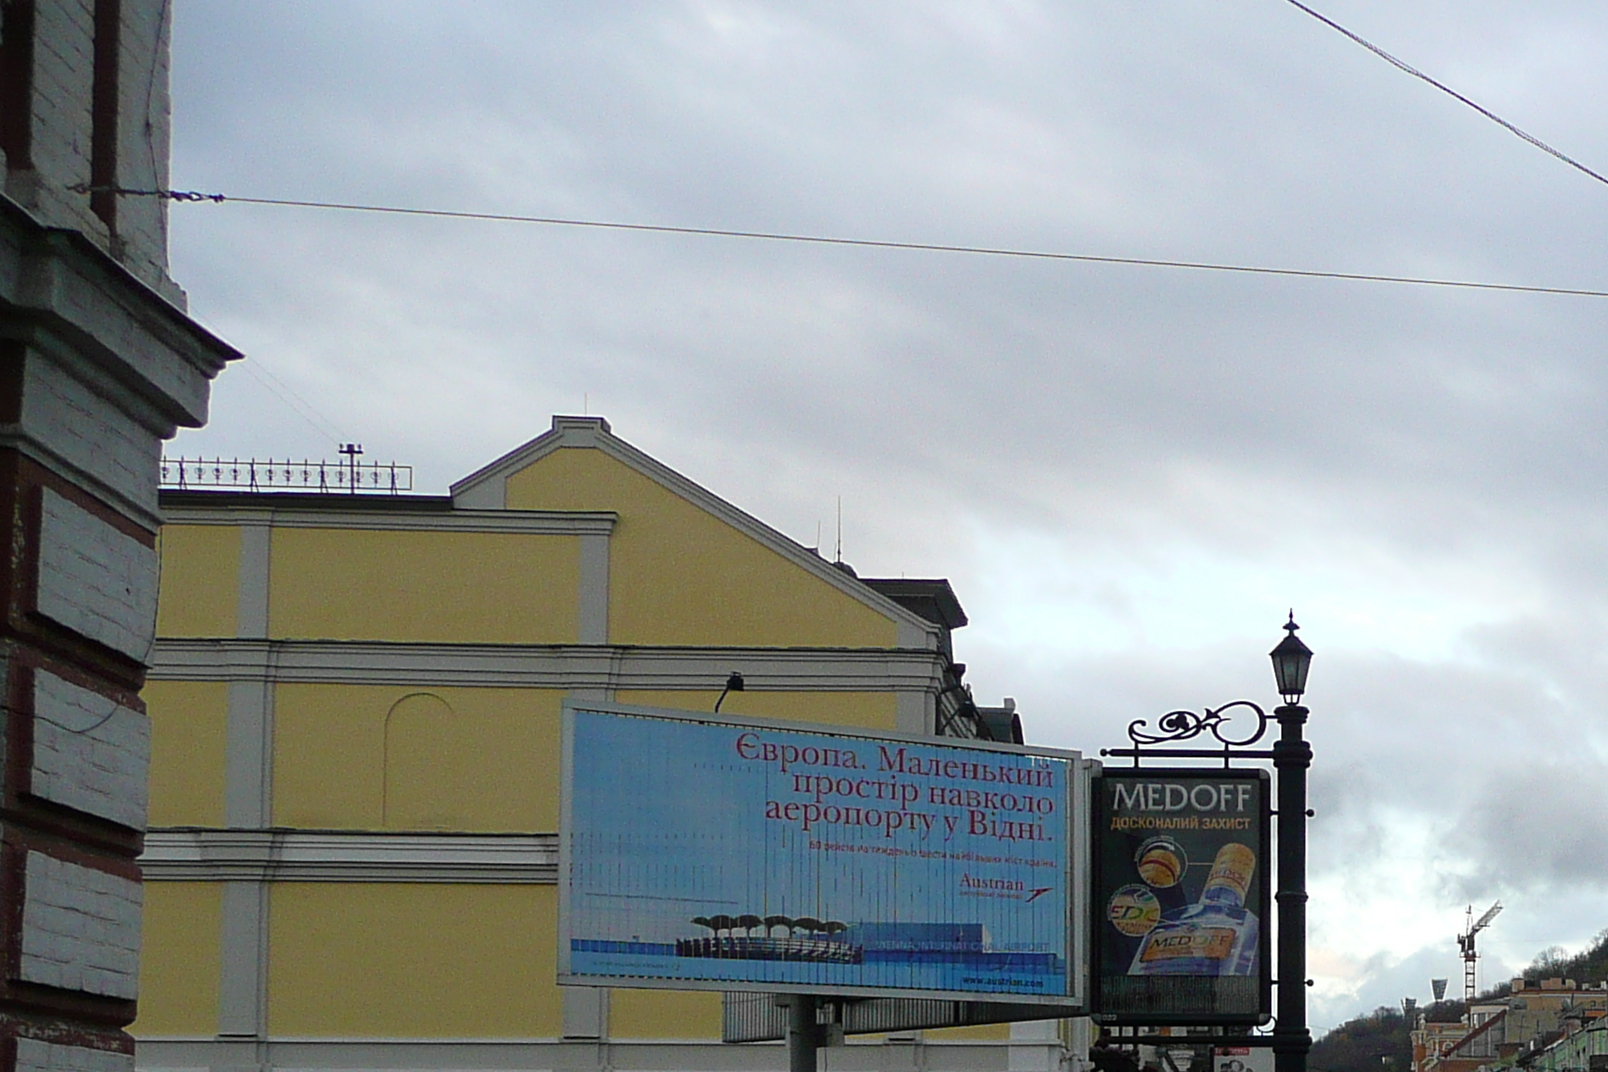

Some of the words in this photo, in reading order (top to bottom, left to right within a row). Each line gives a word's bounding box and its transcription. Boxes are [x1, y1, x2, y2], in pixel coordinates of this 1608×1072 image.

[736, 732, 866, 773] Європа.
[877, 745, 1054, 788] Маленький
[792, 773, 920, 811] простір
[928, 785, 1054, 816] навколо
[1113, 783, 1252, 812] MEDOFF
[765, 799, 936, 840] аеропорту
[943, 813, 961, 843] у
[967, 808, 1054, 844] Відні.
[1110, 816, 1199, 831] ДОСКОНАЛИЙ
[1201, 818, 1251, 830] ЗАХИСТ
[960, 872, 1024, 892] Austrian
[1149, 935, 1230, 949] MEDOFF
[962, 975, 1044, 988] www.austrian.com
